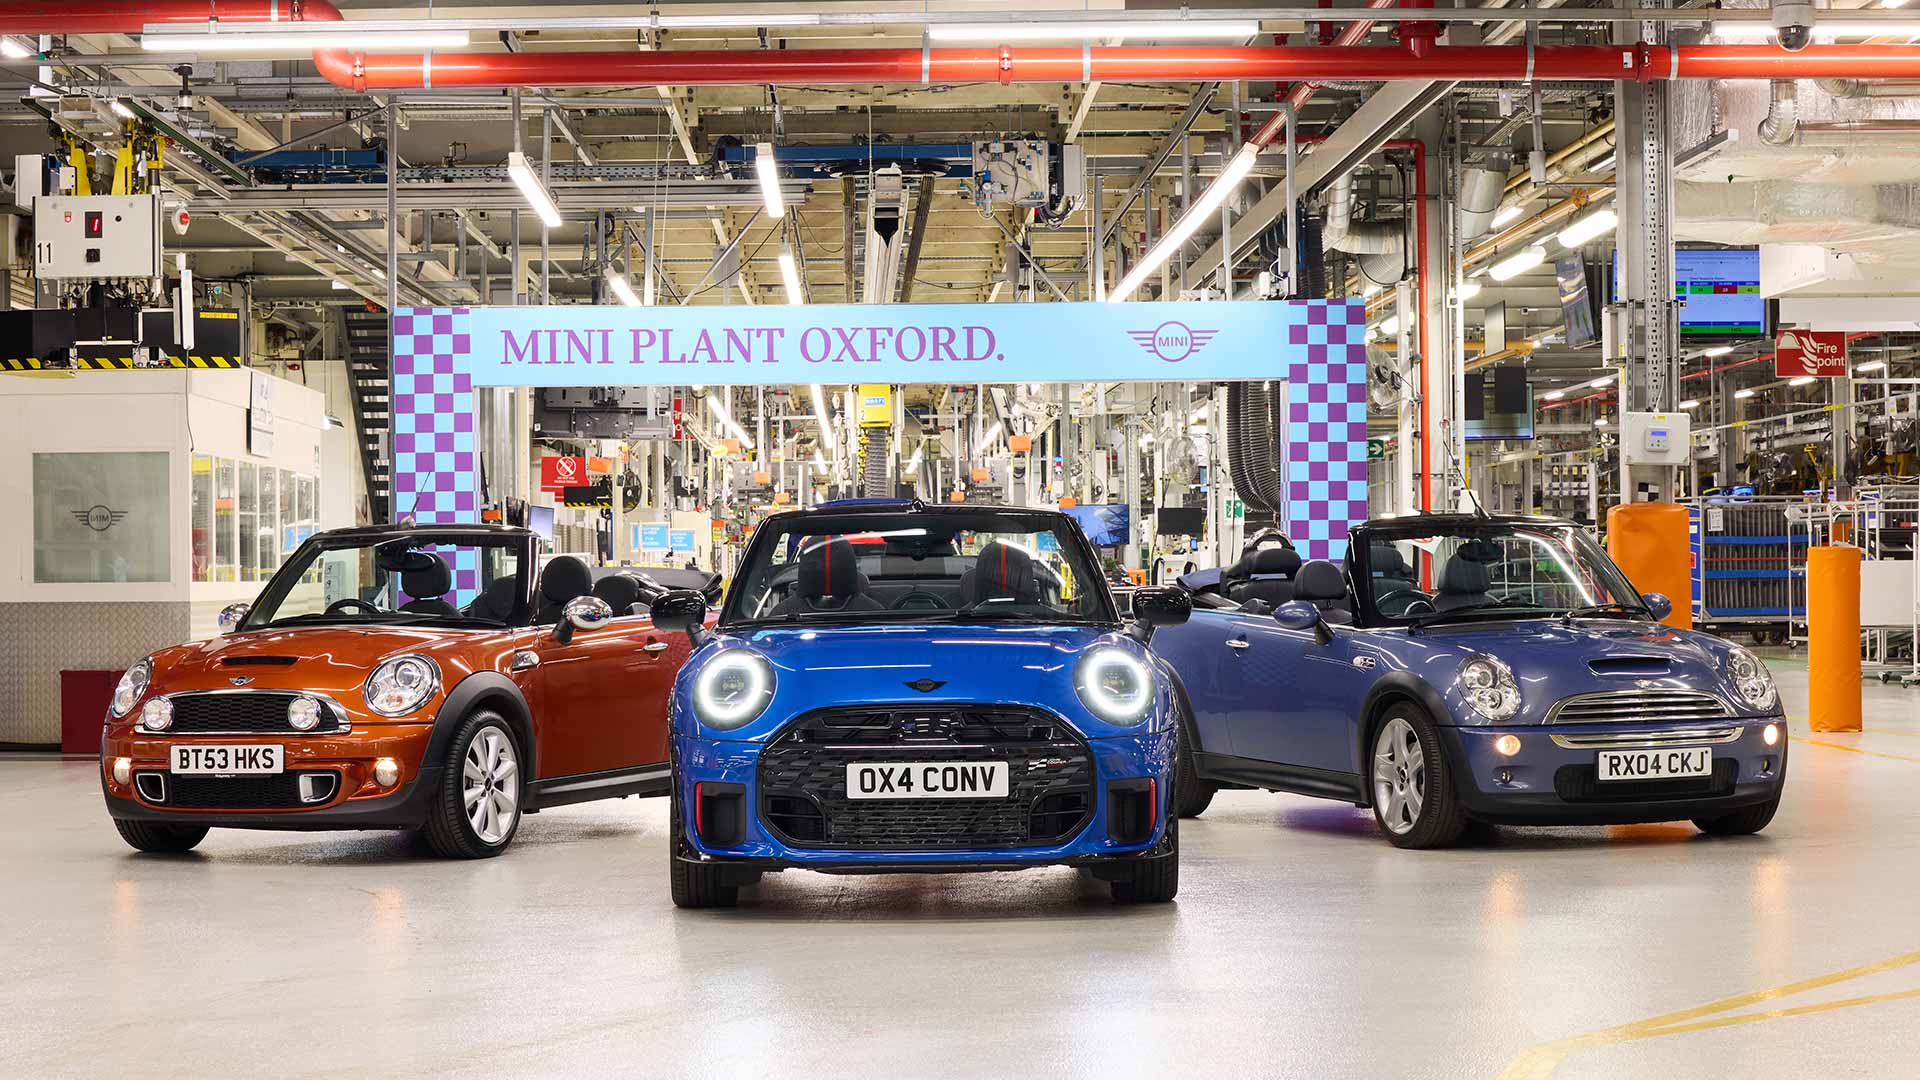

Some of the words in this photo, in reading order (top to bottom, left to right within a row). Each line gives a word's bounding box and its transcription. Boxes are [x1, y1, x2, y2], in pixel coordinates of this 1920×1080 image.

[37, 242, 52, 264] 11
[500, 328, 614, 365] MINI
[629, 327, 785, 364] PLANT
[799, 325, 1006, 363] OXFORD.
[1158, 336, 1189, 347] MINI
[1817, 343, 1838, 354] Fire
[1817, 356, 1845, 369] point
[178, 748, 229, 770] BT53
[235, 748, 274, 769] HKS
[1608, 753, 1662, 776] RX04
[1667, 751, 1705, 774] CKJ
[859, 767, 914, 793] OX4
[922, 765, 996, 792] CONV
